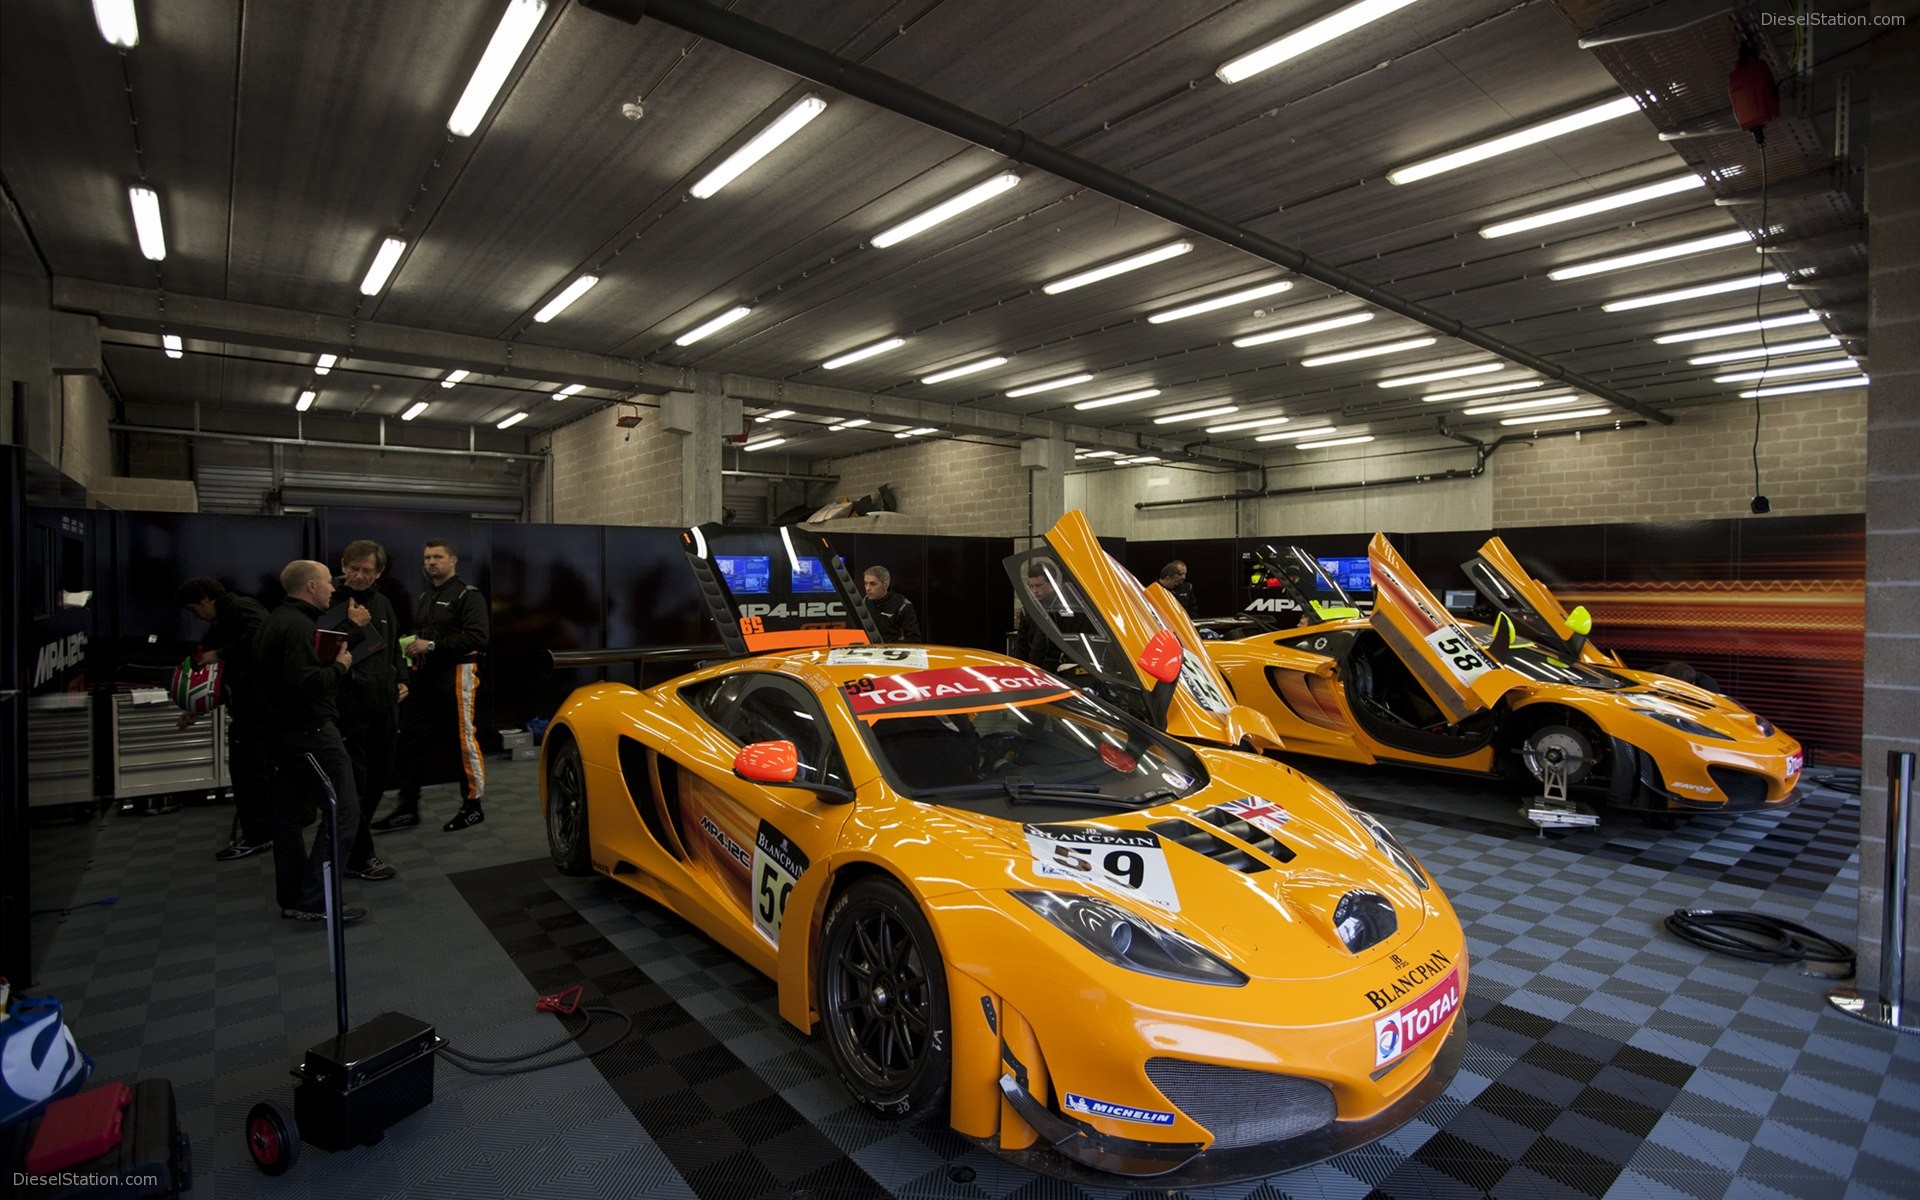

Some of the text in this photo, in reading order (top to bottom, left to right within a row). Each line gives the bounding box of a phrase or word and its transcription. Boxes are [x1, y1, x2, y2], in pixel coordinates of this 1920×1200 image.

[1438, 637, 1483, 672] 58
[843, 677, 876, 695] 59
[860, 682, 981, 705] TOTAL
[699, 815, 753, 869] MP4-12C
[758, 832, 807, 880] BLANCPAIN
[1028, 829, 1155, 847] BLANCPAIN
[1052, 844, 1144, 890] 59
[1364, 949, 1452, 1011] BLANCPAIN
[1401, 986, 1459, 1041] TOTAL
[1092, 1102, 1170, 1122] MICHELIN
